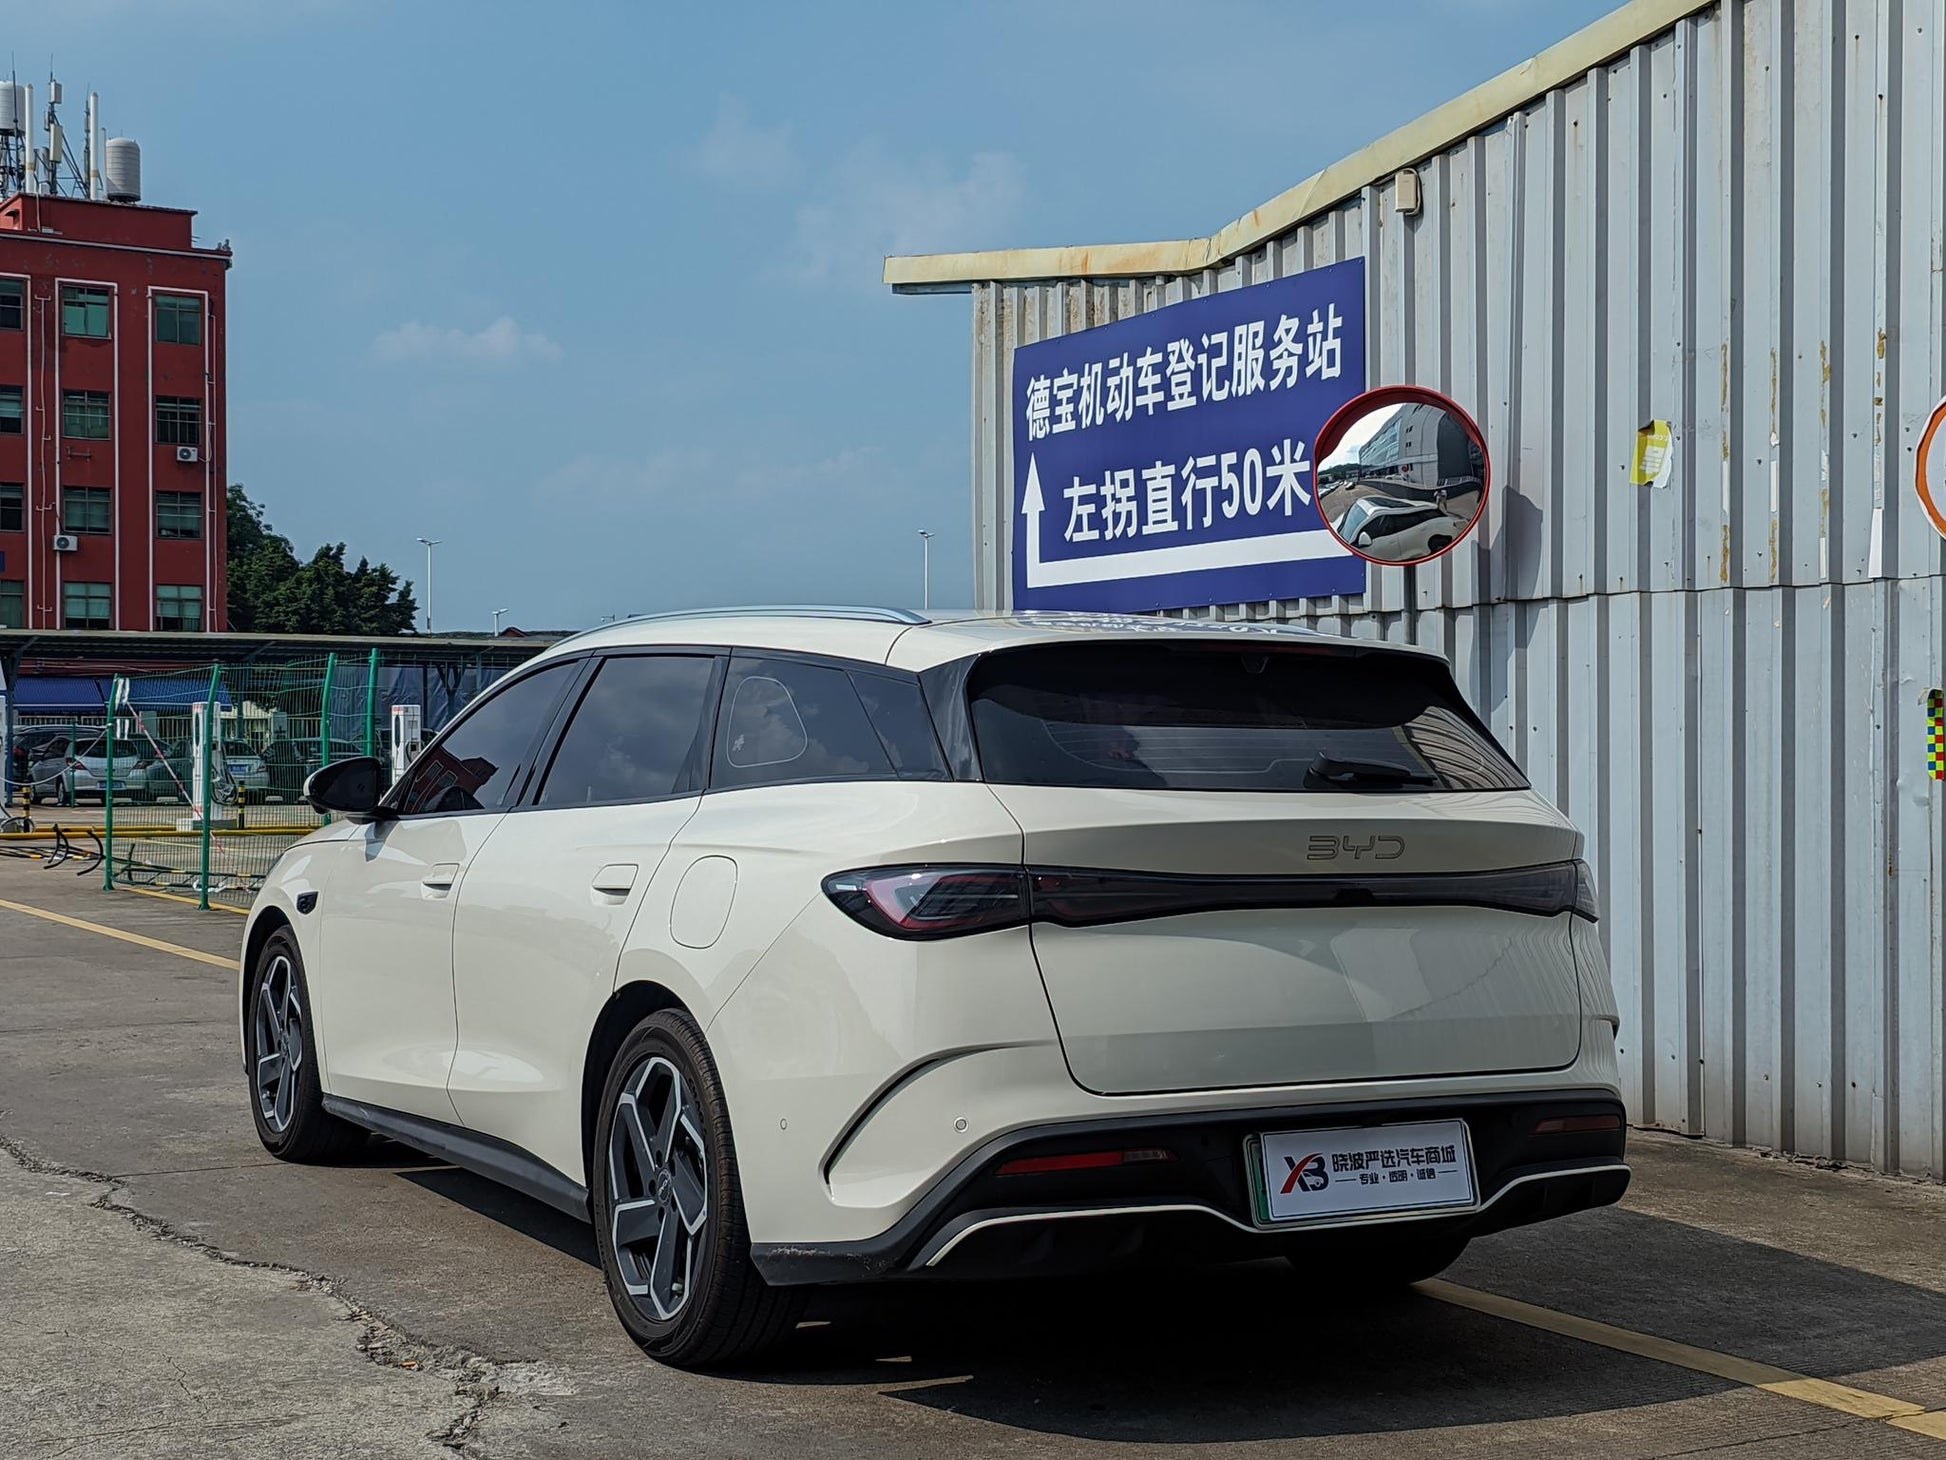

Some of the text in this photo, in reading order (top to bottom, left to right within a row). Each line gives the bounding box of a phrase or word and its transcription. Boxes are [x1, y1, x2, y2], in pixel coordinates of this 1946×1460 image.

[1025, 303, 1343, 441] 德宝机动车登记服务站
[1063, 438, 1312, 543] 左拐直行50米
[1307, 835, 1405, 860] BYD
[1331, 1145, 1457, 1172] 晓波严选汽车商城
